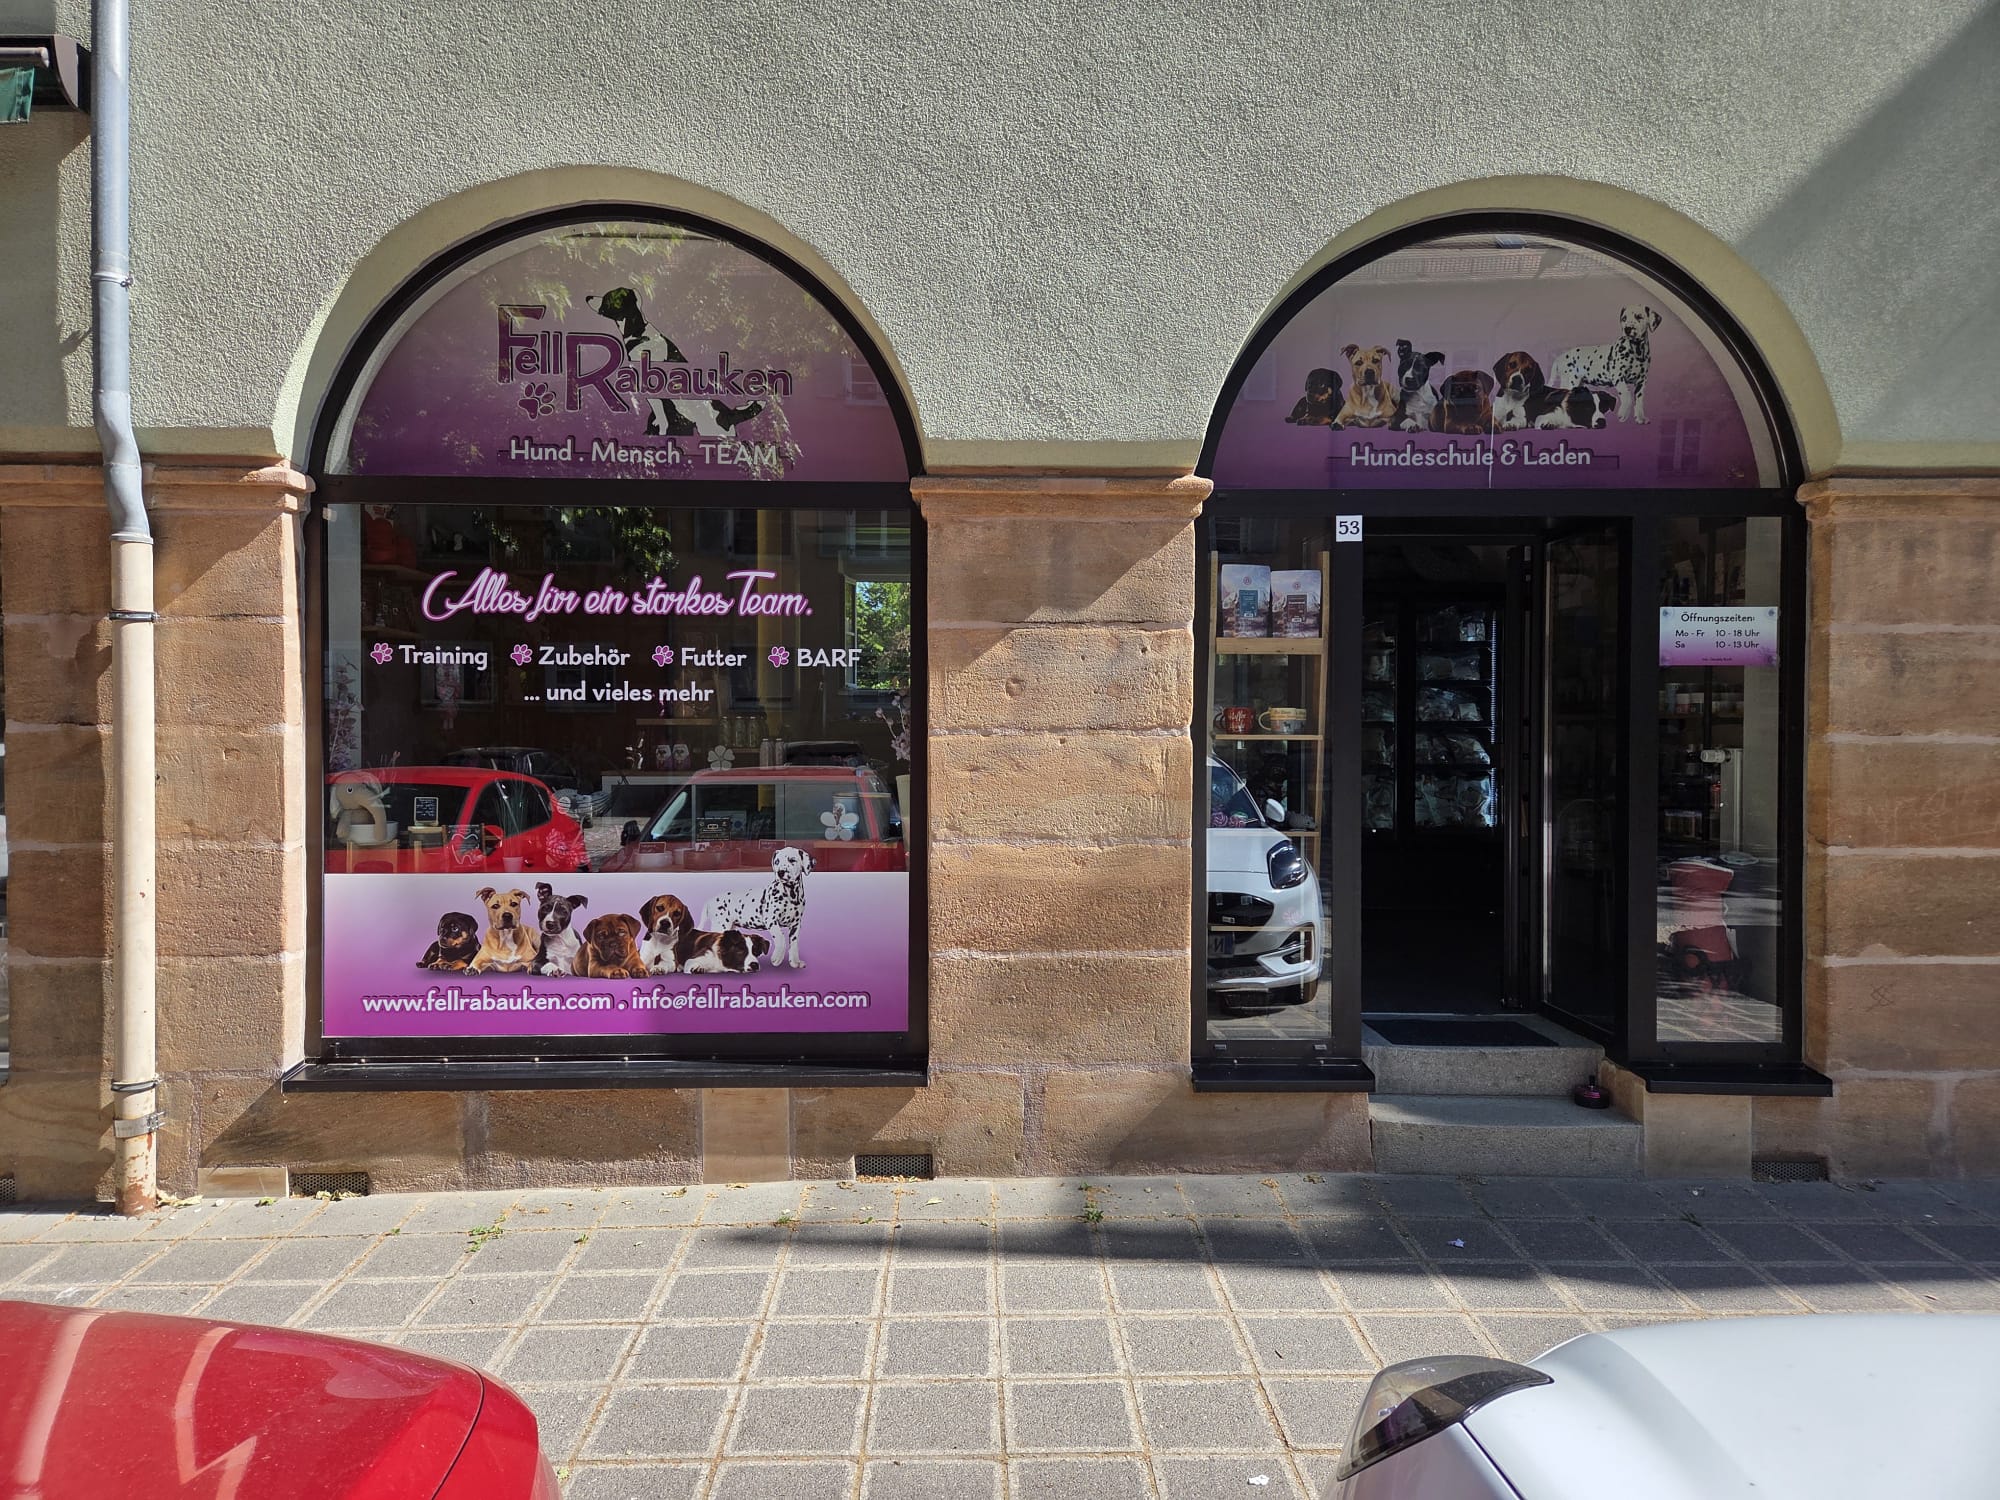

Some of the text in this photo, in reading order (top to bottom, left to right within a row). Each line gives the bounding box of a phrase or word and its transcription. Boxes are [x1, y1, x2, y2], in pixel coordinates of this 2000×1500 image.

[509, 438, 573, 462] Hund
[591, 440, 681, 465] Mensch
[699, 443, 778, 466] TEAM
[1350, 443, 1592, 467] Hundeschule & Laden
[1338, 520, 1360, 536] 53
[421, 566, 814, 623] Alles für ein starkes Team.
[1681, 611, 1755, 624] Öffnungszeiten:
[1675, 629, 1689, 637] Mo
[1696, 629, 1705, 637] Fr
[1715, 629, 1726, 637] 10
[1733, 629, 1742, 637] 18
[1744, 629, 1760, 637] Uhr
[1675, 640, 1686, 649] Sa
[1715, 641, 1726, 649] 10
[1733, 641, 1742, 649] 13
[1743, 641, 1760, 649] Uhr
[398, 644, 863, 671] Training Zubehör Futter BARF
[546, 680, 586, 701] und
[591, 680, 652, 701] vieles
[658, 680, 715, 702] mehr
[362, 988, 611, 1012] www.fellrabauken.com
[632, 986, 868, 1010] info@fellrabauken.com
